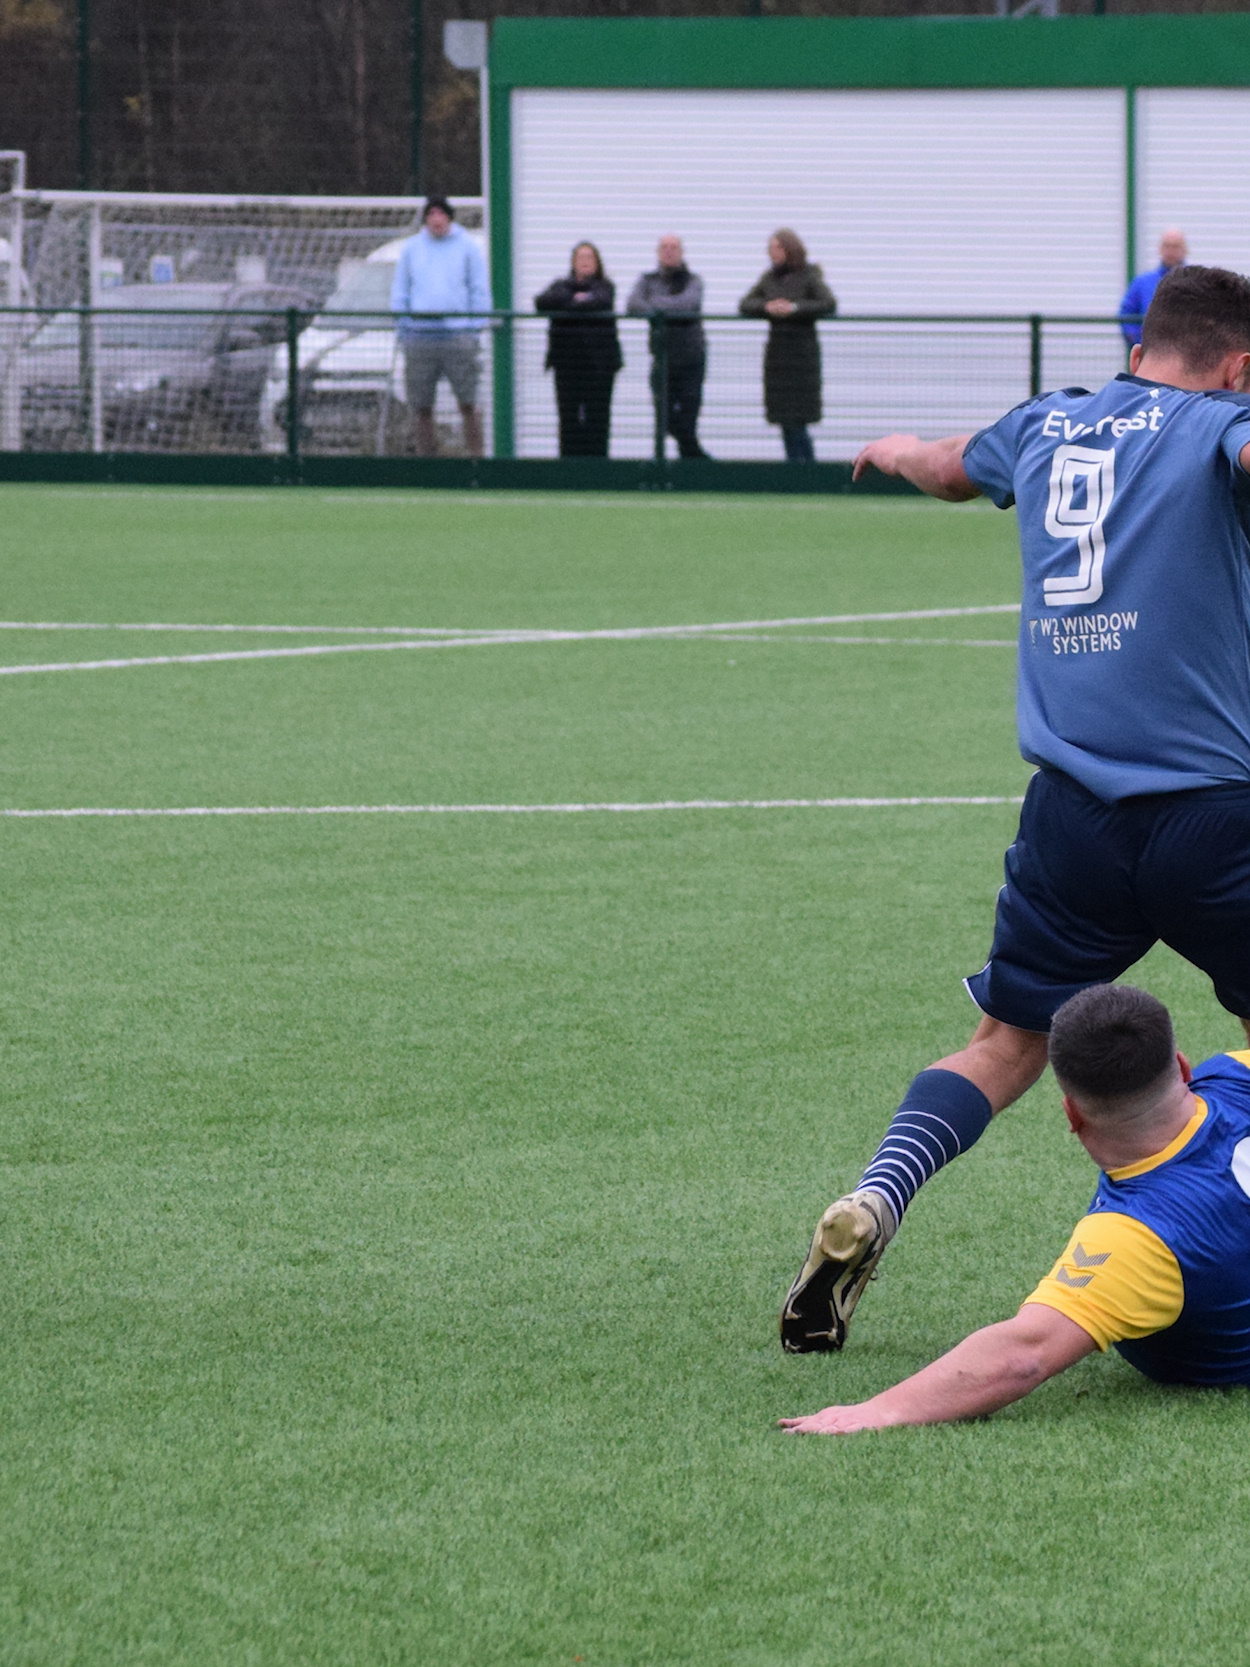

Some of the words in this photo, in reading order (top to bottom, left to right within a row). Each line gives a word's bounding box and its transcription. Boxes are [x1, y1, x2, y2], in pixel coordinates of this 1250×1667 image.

[1044, 445, 1115, 606] 9
[1040, 618, 1060, 636] W2
[1061, 611, 1138, 635] WINDOW
[1053, 632, 1121, 655] SYSTEMS
